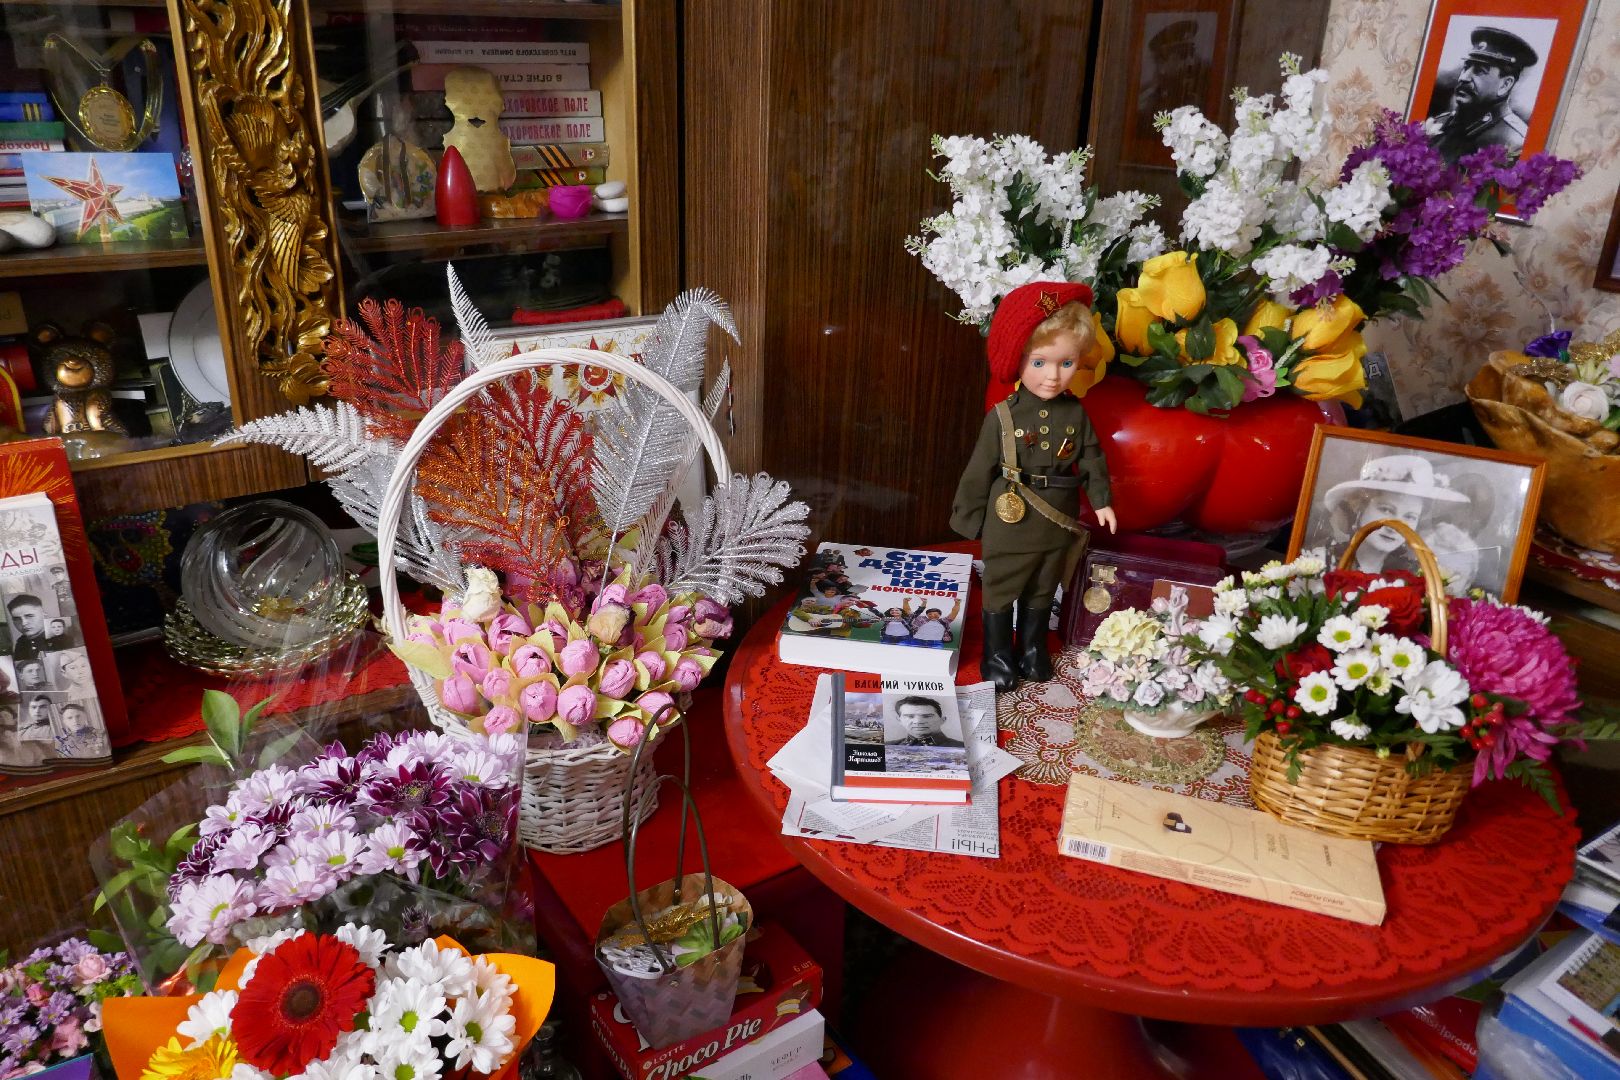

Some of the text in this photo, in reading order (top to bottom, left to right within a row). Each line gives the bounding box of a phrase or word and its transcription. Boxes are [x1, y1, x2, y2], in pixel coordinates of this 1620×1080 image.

[526, 74, 553, 82] ОГНЕ
[555, 74, 562, 82] В
[564, 97, 588, 112] ПОЛЕ
[566, 123, 591, 138] ПОЛЕ
[854, 679, 944, 691] ВАСИЛИЙ ЧУЙКОВ
[645, 1018, 762, 1080] Choco Pie
[654, 1044, 686, 1064] LOTTE
